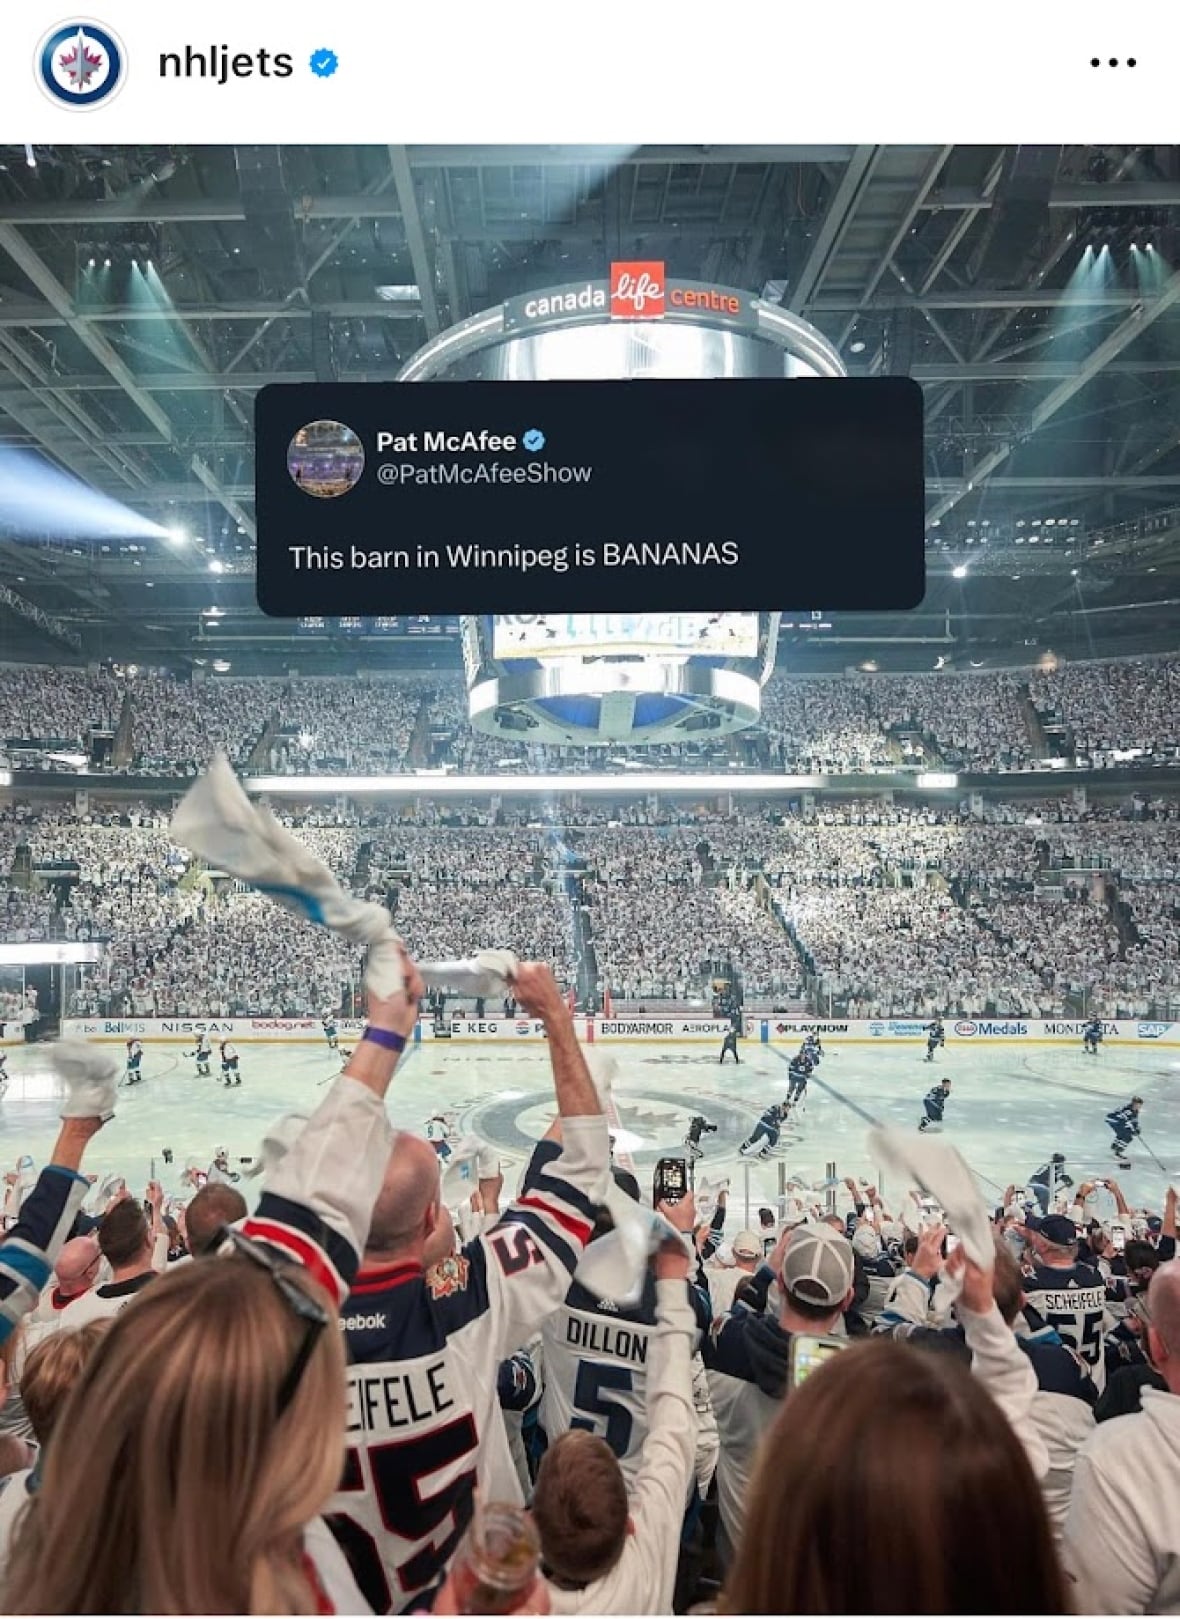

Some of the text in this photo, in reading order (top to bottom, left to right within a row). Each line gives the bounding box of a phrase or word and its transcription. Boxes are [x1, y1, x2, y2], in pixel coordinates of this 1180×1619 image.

[524, 272, 740, 318] canada life centre
[161, 1022, 234, 1032] NISSAN
[251, 1019, 315, 1031] bodog.net
[429, 1023, 498, 1033] TE KEG
[601, 1022, 674, 1035] BODYARMOR
[682, 1023, 730, 1033] AEROPLA
[978, 1022, 1028, 1035] Medals
[1043, 1022, 1119, 1035] MONDTA
[1138, 1024, 1167, 1036] SAP
[338, 1313, 386, 1331] eebok
[566, 1315, 648, 1364] DILLON
[1046, 1311, 1103, 1366] 55
[346, 1361, 454, 1432] EIFELE
[570, 1358, 633, 1458] 5
